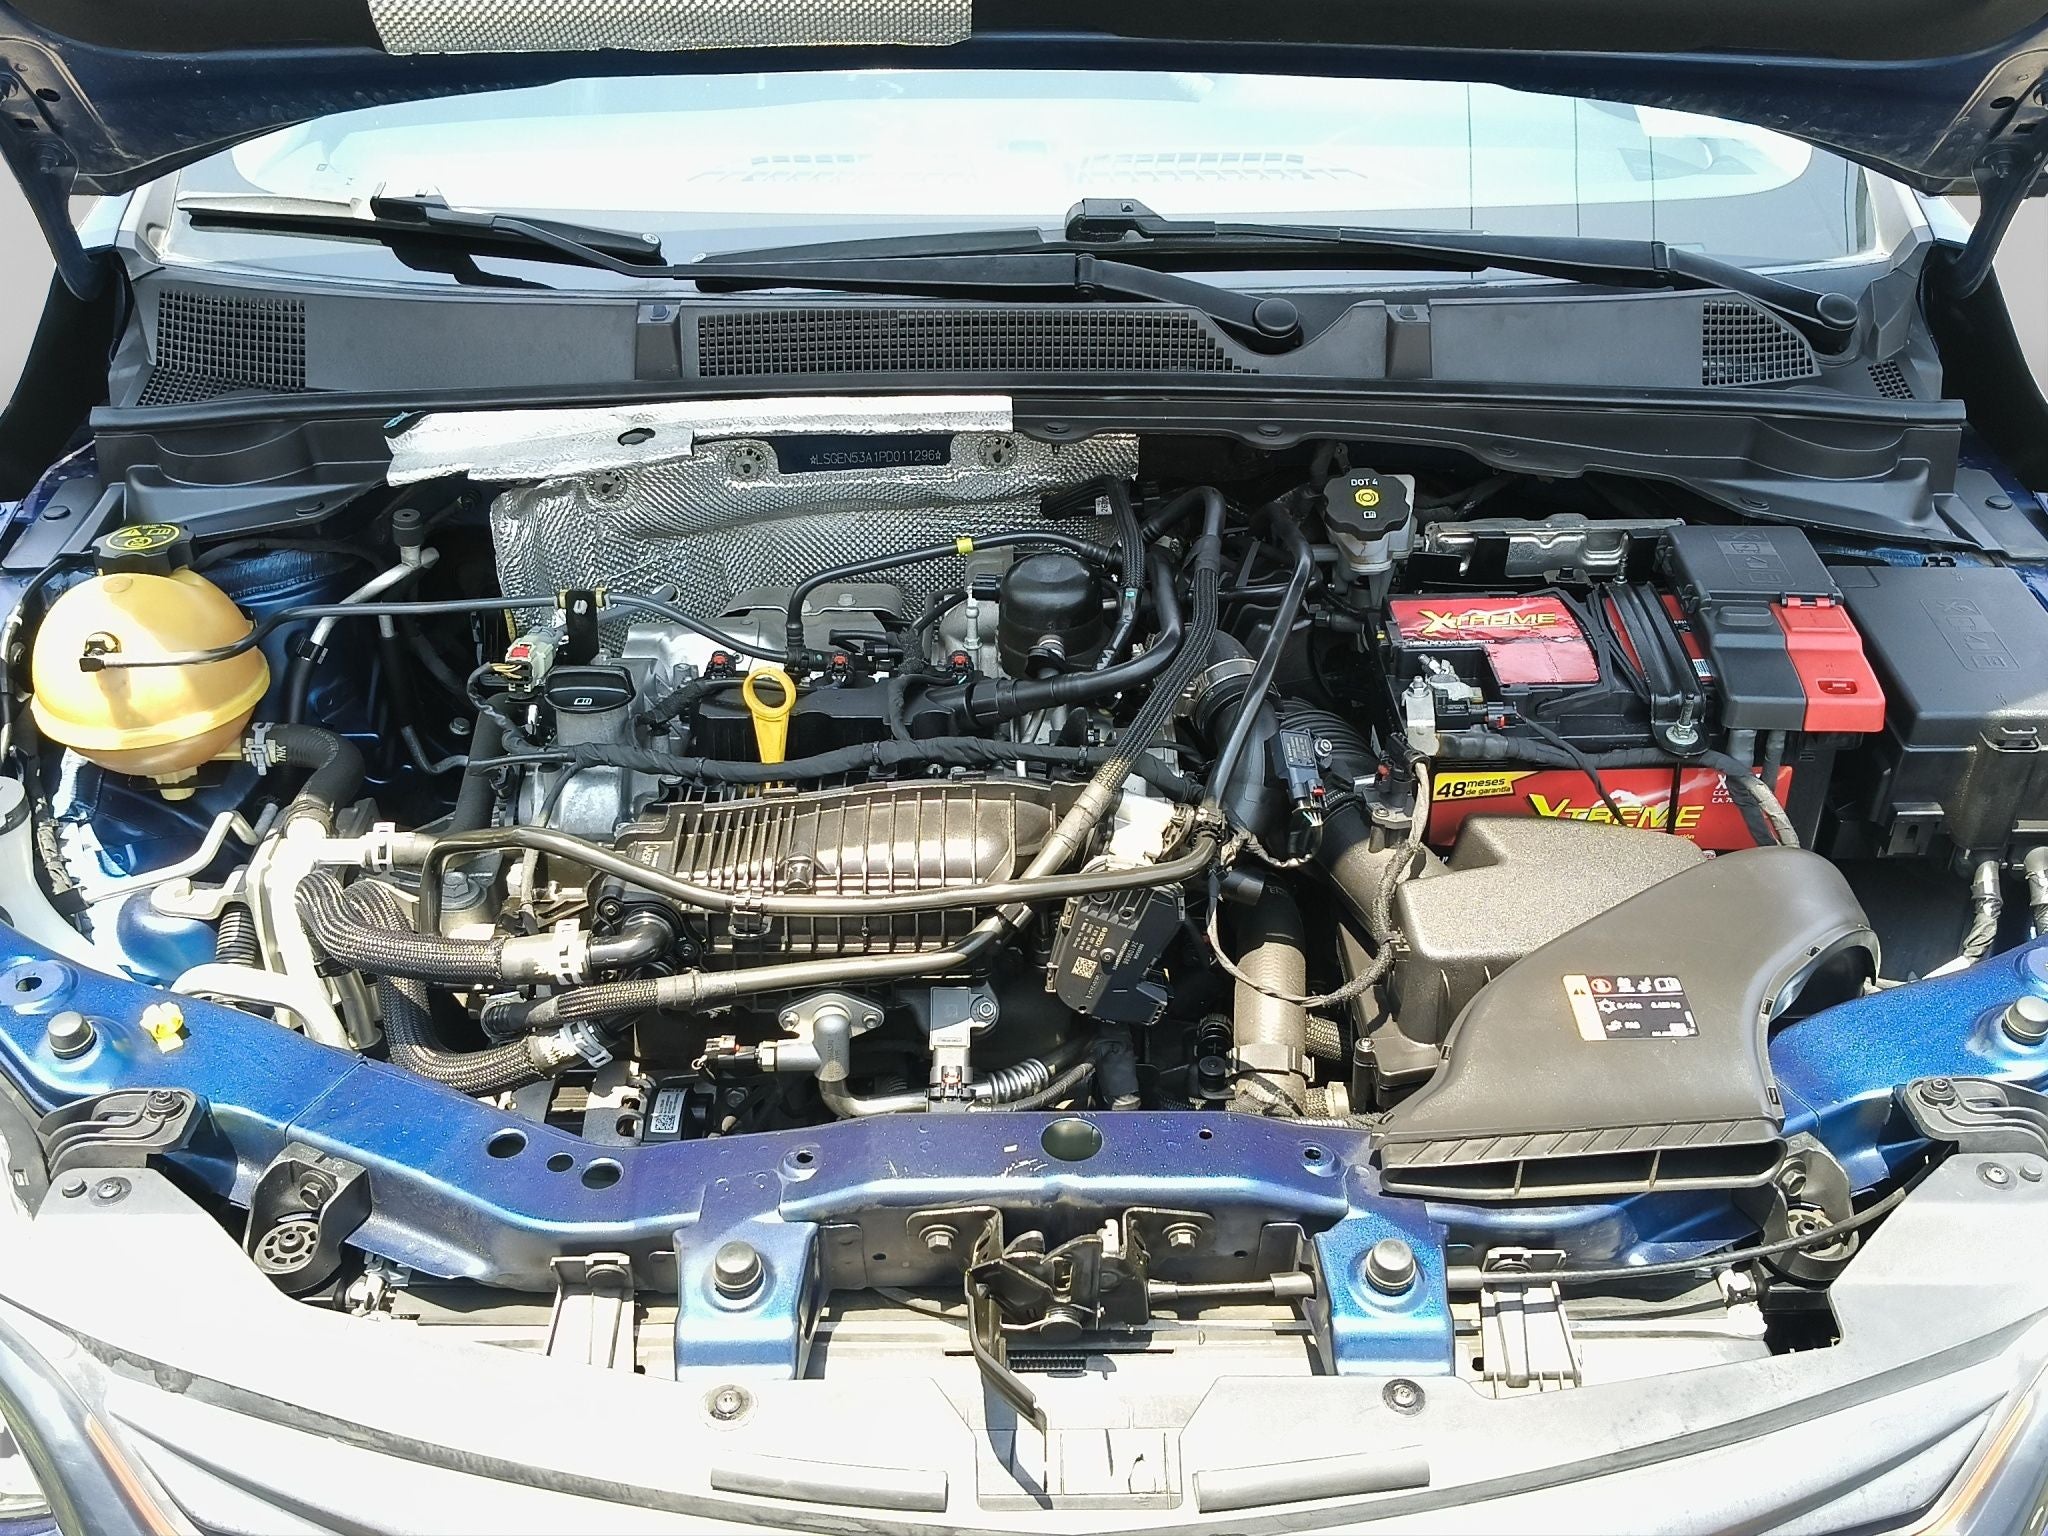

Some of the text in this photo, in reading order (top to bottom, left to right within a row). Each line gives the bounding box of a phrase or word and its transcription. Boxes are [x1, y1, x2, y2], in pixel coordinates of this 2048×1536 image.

[816, 449, 936, 466] LSGEN53A1PD011296
[1350, 478, 1378, 486] DOT 4
[1418, 608, 1556, 634] XTREME
[1436, 778, 1506, 798] 48 meses
